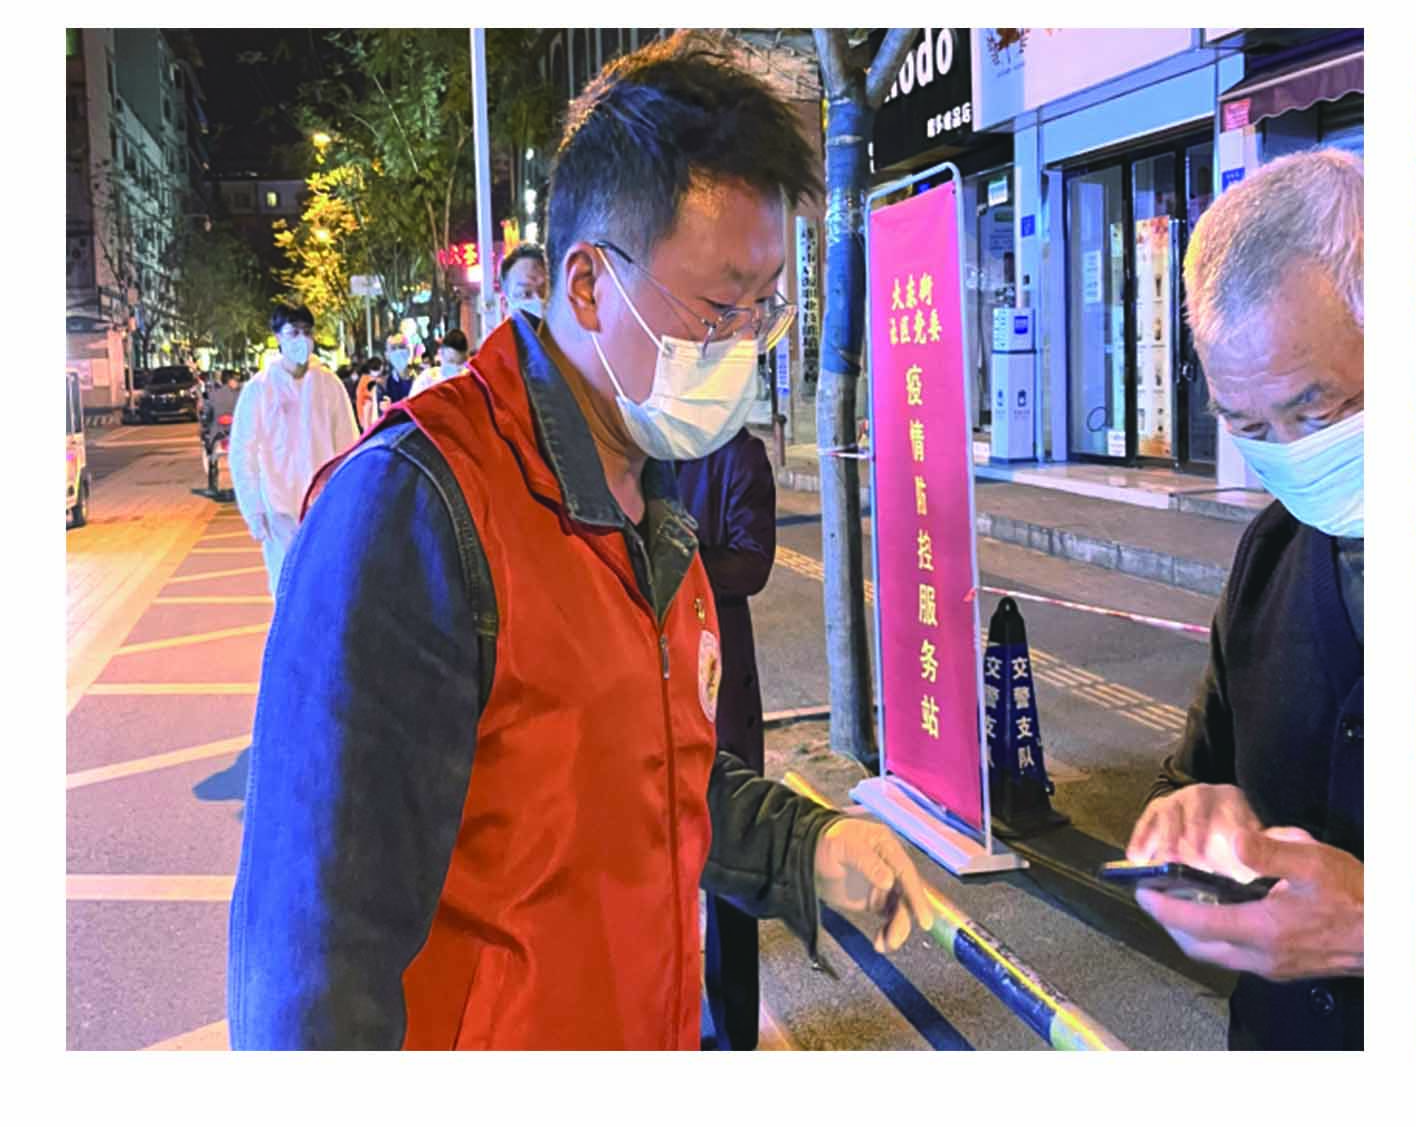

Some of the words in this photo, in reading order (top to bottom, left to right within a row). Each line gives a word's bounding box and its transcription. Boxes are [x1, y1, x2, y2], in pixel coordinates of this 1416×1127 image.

[905, 363, 941, 739] 疫情防控服务站
[1011, 656, 1036, 769] 交警支队
